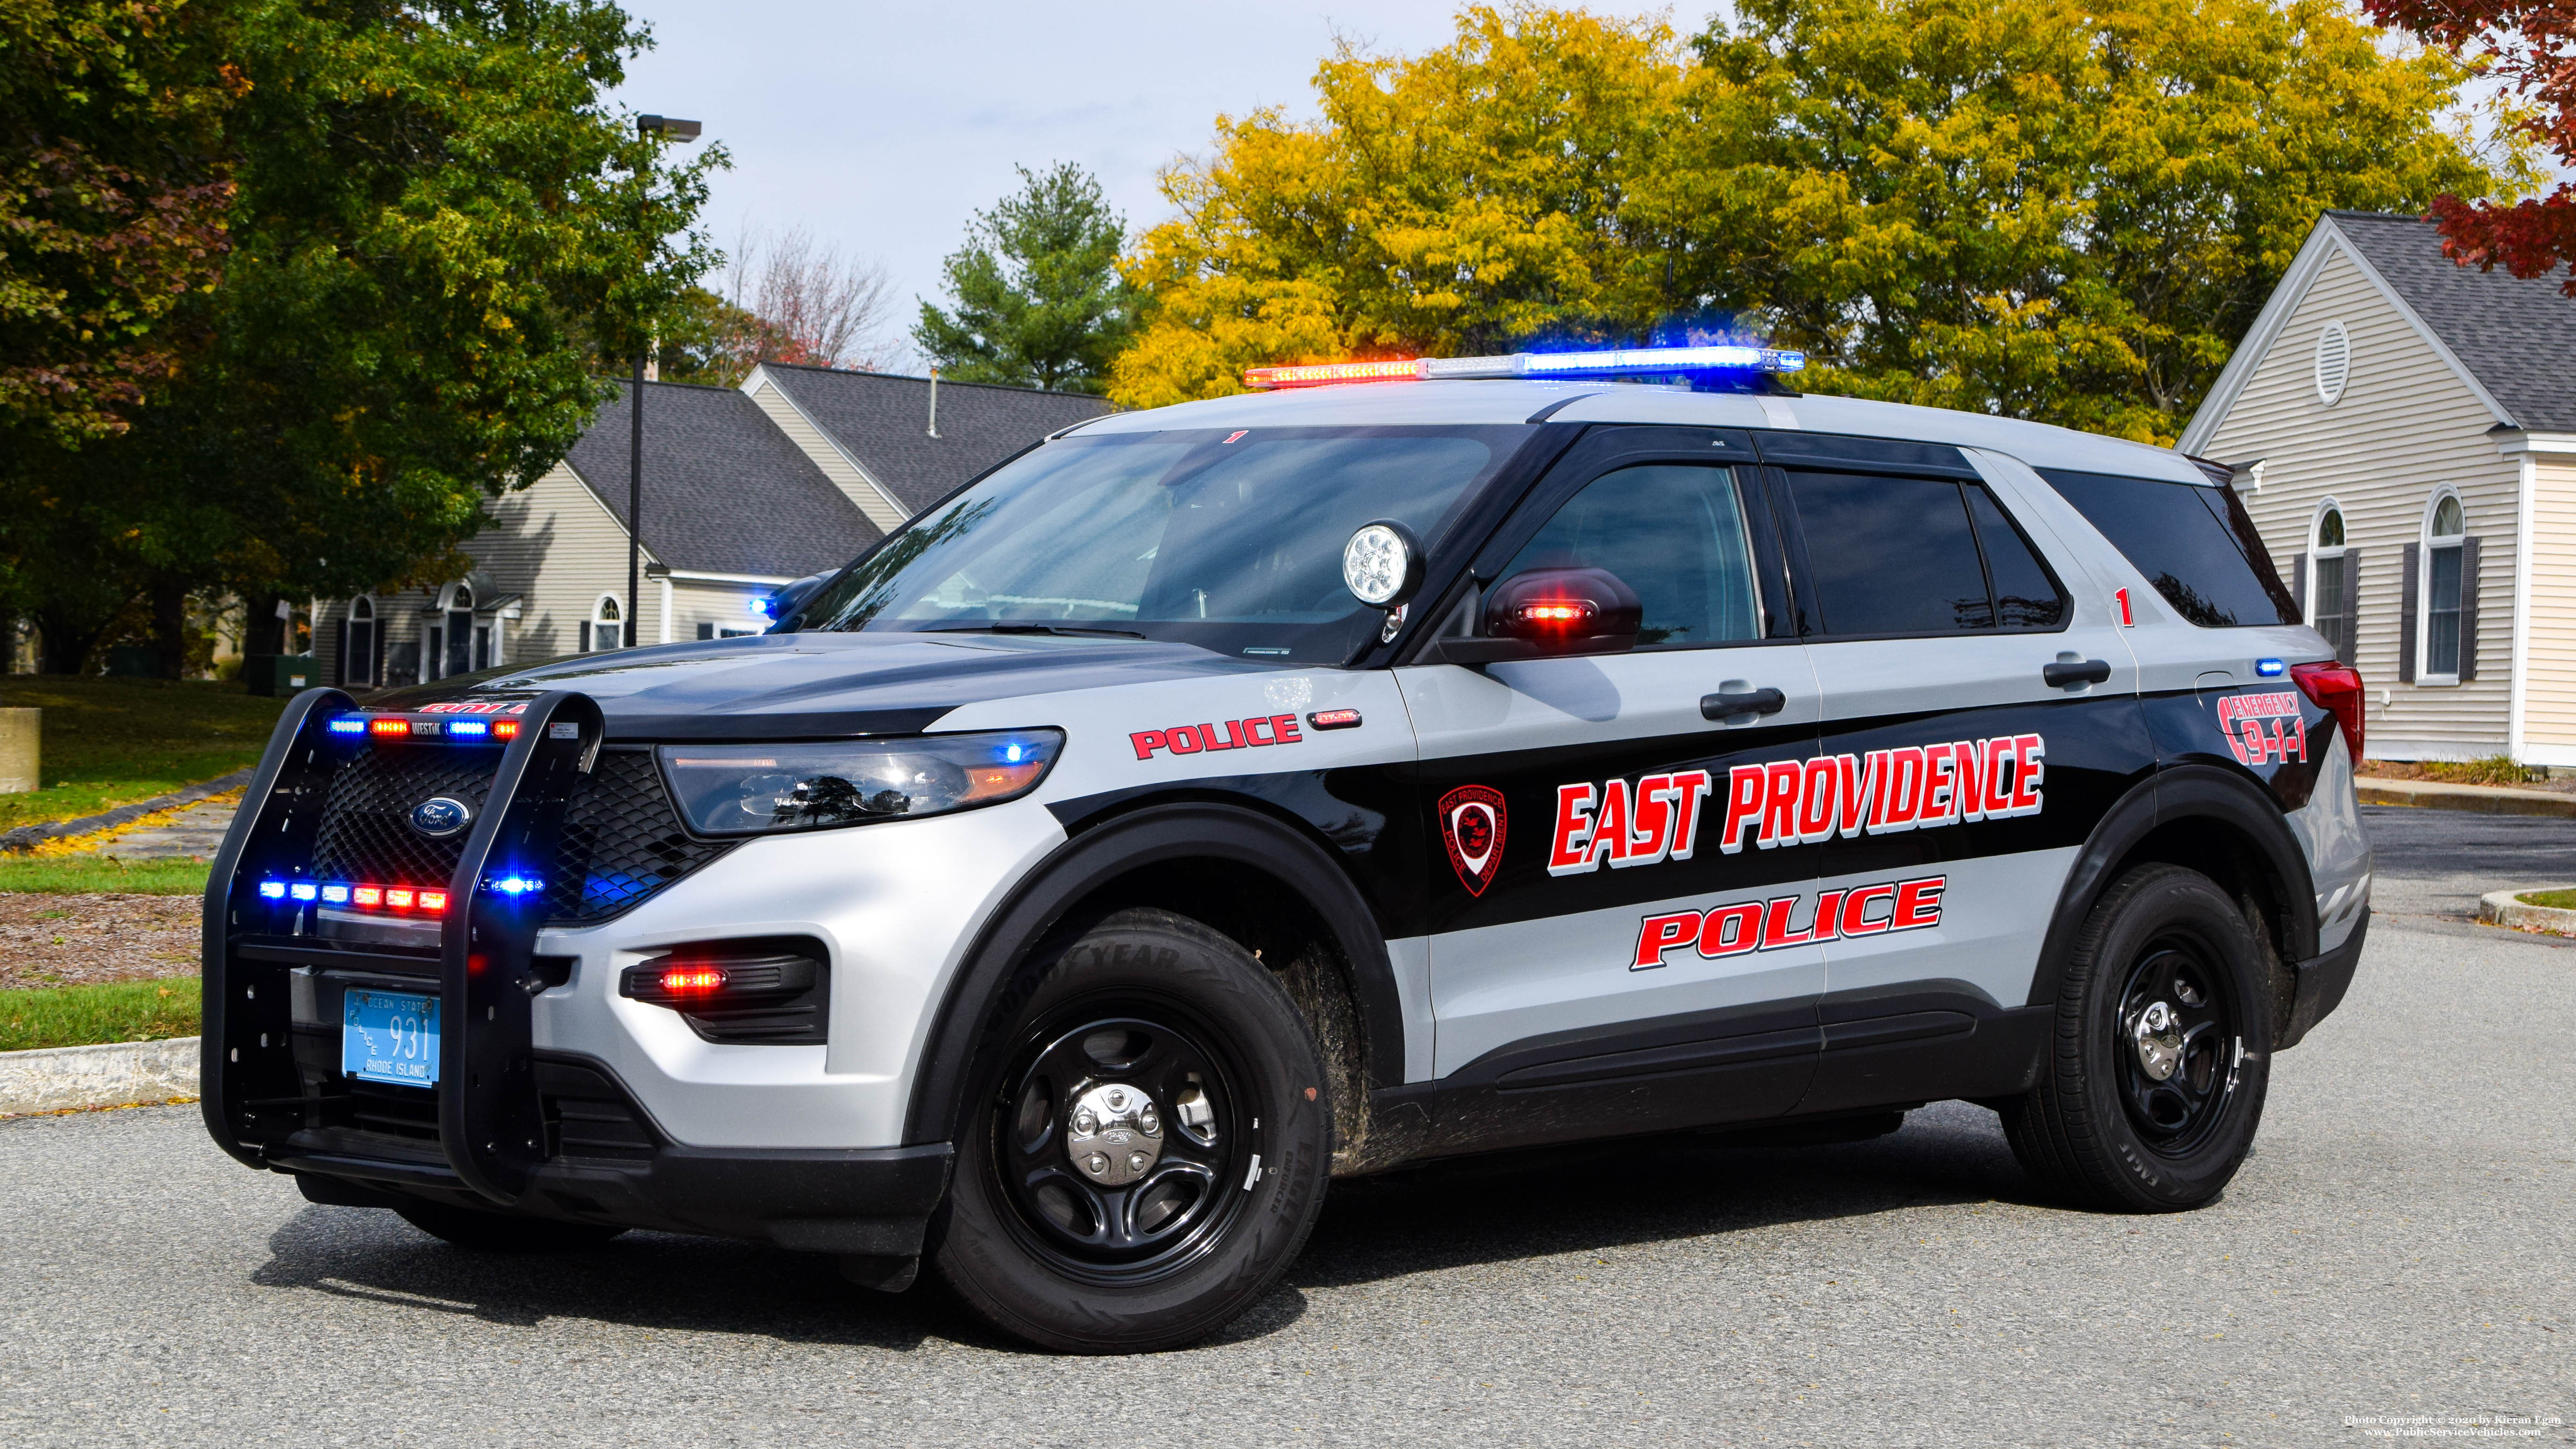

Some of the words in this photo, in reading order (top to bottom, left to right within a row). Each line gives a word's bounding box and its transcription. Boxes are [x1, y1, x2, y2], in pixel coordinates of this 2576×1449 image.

[1222, 430, 1249, 444] 1
[2114, 587, 2135, 628] 1
[2229, 691, 2300, 720] EMERGENCY
[1129, 713, 1302, 760] POLICE
[2241, 716, 2307, 766] 9-1-1
[419, 804, 453, 826] Ford
[1441, 794, 1457, 815] EAST
[1458, 789, 1503, 809] PROVIDENCE
[1547, 769, 1712, 876] EAST
[1720, 733, 2045, 854] PROVIDENCE
[1446, 830, 1467, 874] POLICE
[1480, 812, 1504, 882] DEPARTMENT
[1629, 875, 1947, 972] POLICE
[368, 997, 395, 1009] OCEAN
[401, 1000, 427, 1013] STATE
[350, 1010, 377, 1056] POLICE
[390, 1015, 428, 1062] 931
[366, 1059, 393, 1075] RHODE
[396, 1062, 425, 1078] ISLAND
[1270, 1150, 1294, 1215] ENFORCER
